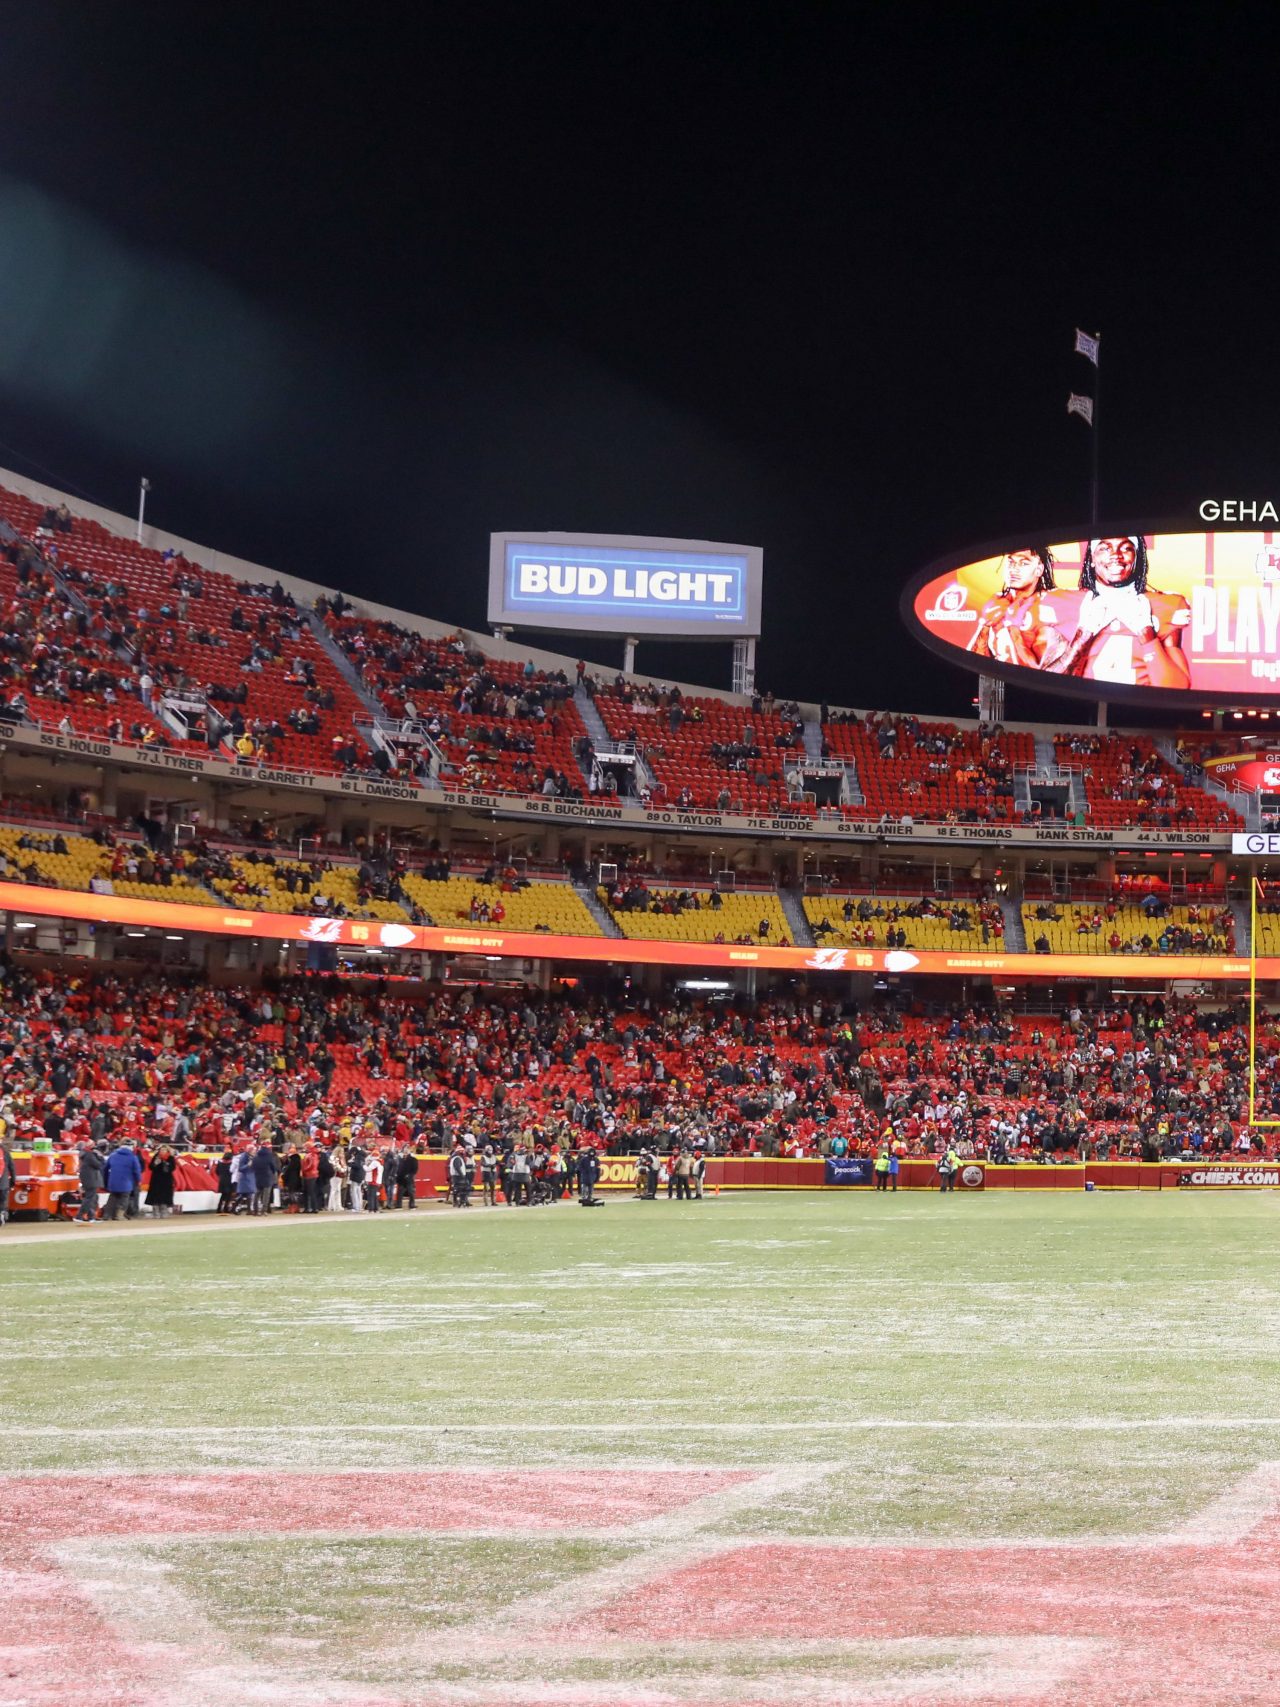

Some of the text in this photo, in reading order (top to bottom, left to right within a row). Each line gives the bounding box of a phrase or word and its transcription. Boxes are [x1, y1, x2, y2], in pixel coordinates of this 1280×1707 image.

[1200, 500, 1279, 522] GEHA
[520, 563, 608, 596] BUD
[40, 734, 112, 757] 55 E. HOLUB
[136, 751, 149, 762] 77
[163, 754, 204, 771] TYRER
[1216, 762, 1237, 774] GEHA
[229, 766, 241, 776] 21
[257, 770, 316, 788] GARRETT
[340, 781, 420, 800] 16 L. DAWSON
[457, 794, 470, 805] B.
[471, 796, 501, 808] BELL
[526, 802, 623, 819] 86 B. BUCHANAN
[646, 812, 723, 827] 89 O. TAYLOR
[747, 819, 814, 832] 71 E. BUDDE
[837, 823, 914, 836] 63 W. LANIER
[936, 827, 1013, 839] 18 E. THOMAS
[1036, 830, 1114, 841] HANK STRAM
[1137, 833, 1211, 844] 44 J. WILSON
[351, 926, 369, 940] VS
[444, 936, 503, 948] KANSAS CITY
[856, 953, 873, 966] VS
[947, 958, 1004, 968] KANSAS CITY
[598, 1163, 641, 1182] DOM
[834, 1166, 861, 1175] peacock
[1191, 1172, 1279, 1185] CHIEFS.COM
